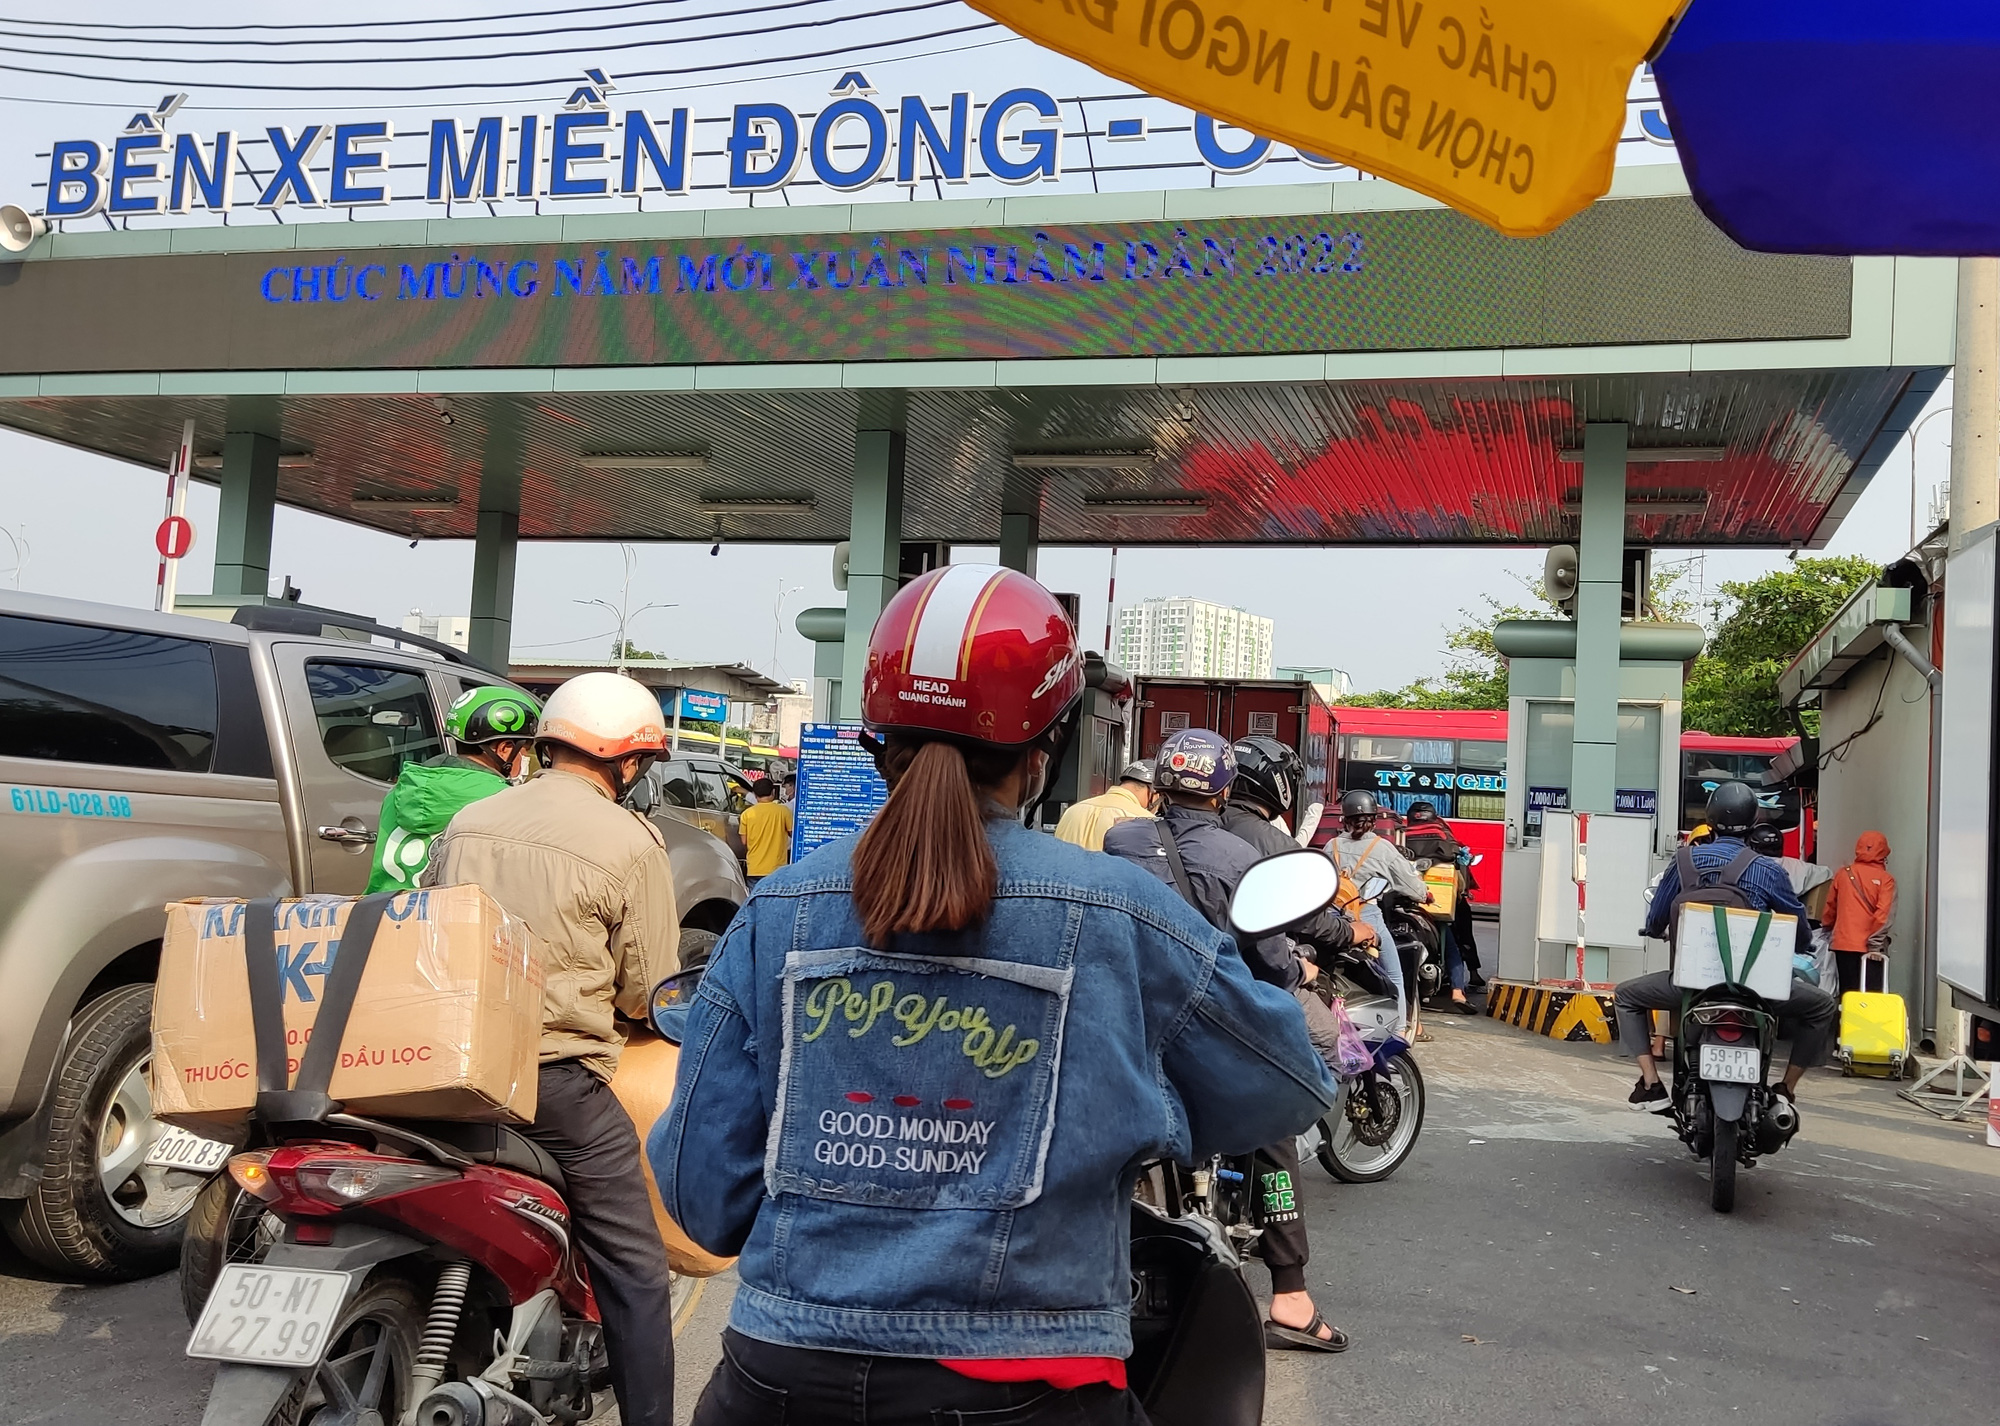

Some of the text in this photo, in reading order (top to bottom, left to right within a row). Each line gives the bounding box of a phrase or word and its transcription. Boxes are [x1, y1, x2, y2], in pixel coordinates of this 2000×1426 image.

[45, 93, 238, 219] BẾN
[256, 119, 395, 210] XE
[425, 67, 695, 203] MIỀN
[726, 71, 1063, 193] ĐÔNG
[260, 256, 386, 303] CHÚC
[396, 252, 541, 299] MỪNG
[551, 250, 663, 297] NĂM
[675, 243, 776, 293] MỚI
[787, 236, 934, 290] XUÂN
[942, 231, 1110, 285] NHÂM
[1253, 231, 1363, 276] 2022
[898, 690, 966, 708] QUANG KHÁNH
[913, 680, 949, 694] HEAD
[1160, 749, 1217, 775] PRIS
[1375, 764, 1415, 787] TÝ
[10, 788, 132, 818] 61LD-028.98
[184, 1057, 249, 1084] THUỐC
[341, 1045, 385, 1068] ĐẦU
[392, 1046, 432, 1066] LỌC
[1710, 1048, 1749, 1065] 59-P1
[1704, 1063, 1756, 1081] 219.48
[818, 1109, 996, 1145] GOOD MONDAY
[153, 1137, 226, 1167] 900.83
[815, 1139, 988, 1175] GOOD SUNDAY
[1261, 1170, 1292, 1192] YA
[1263, 1190, 1295, 1213] ME
[229, 1272, 325, 1315] 50-N1
[198, 1313, 321, 1359] 427.99
